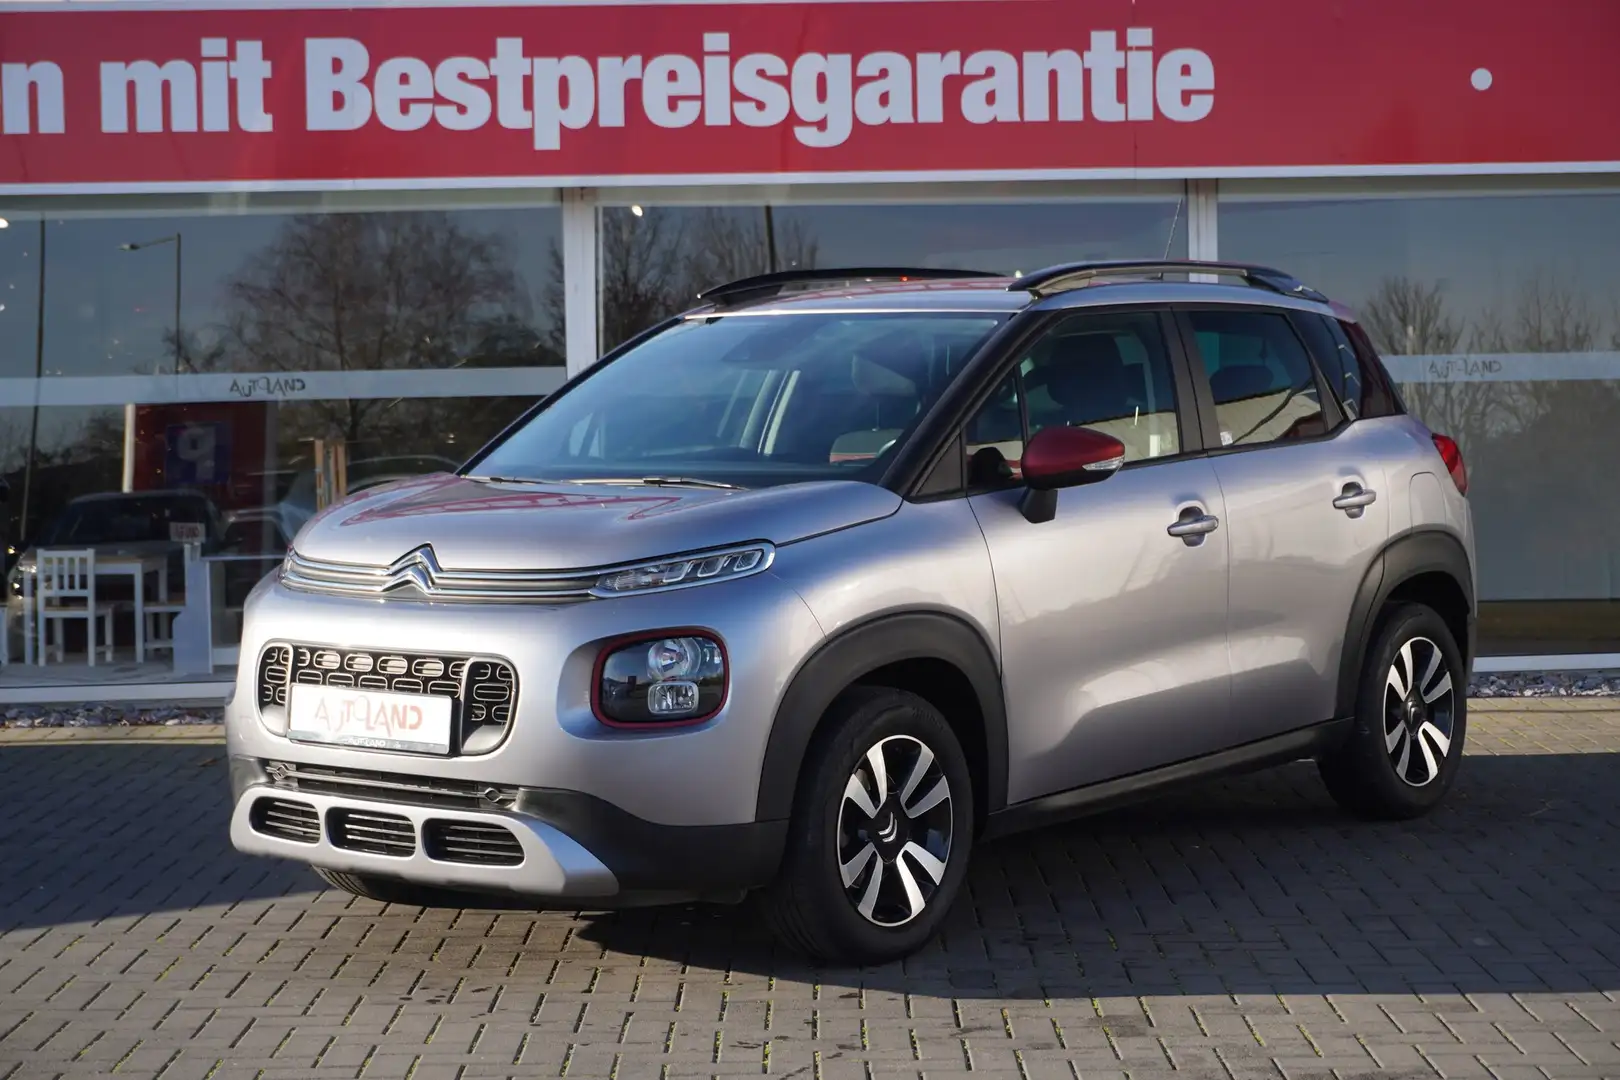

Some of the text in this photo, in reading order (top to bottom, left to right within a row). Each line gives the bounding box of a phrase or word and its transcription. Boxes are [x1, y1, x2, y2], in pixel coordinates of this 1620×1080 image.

[100, 38, 273, 133] mit
[305, 27, 1215, 151] Bestpreisgarantie
[229, 376, 306, 398] AUTOLAND
